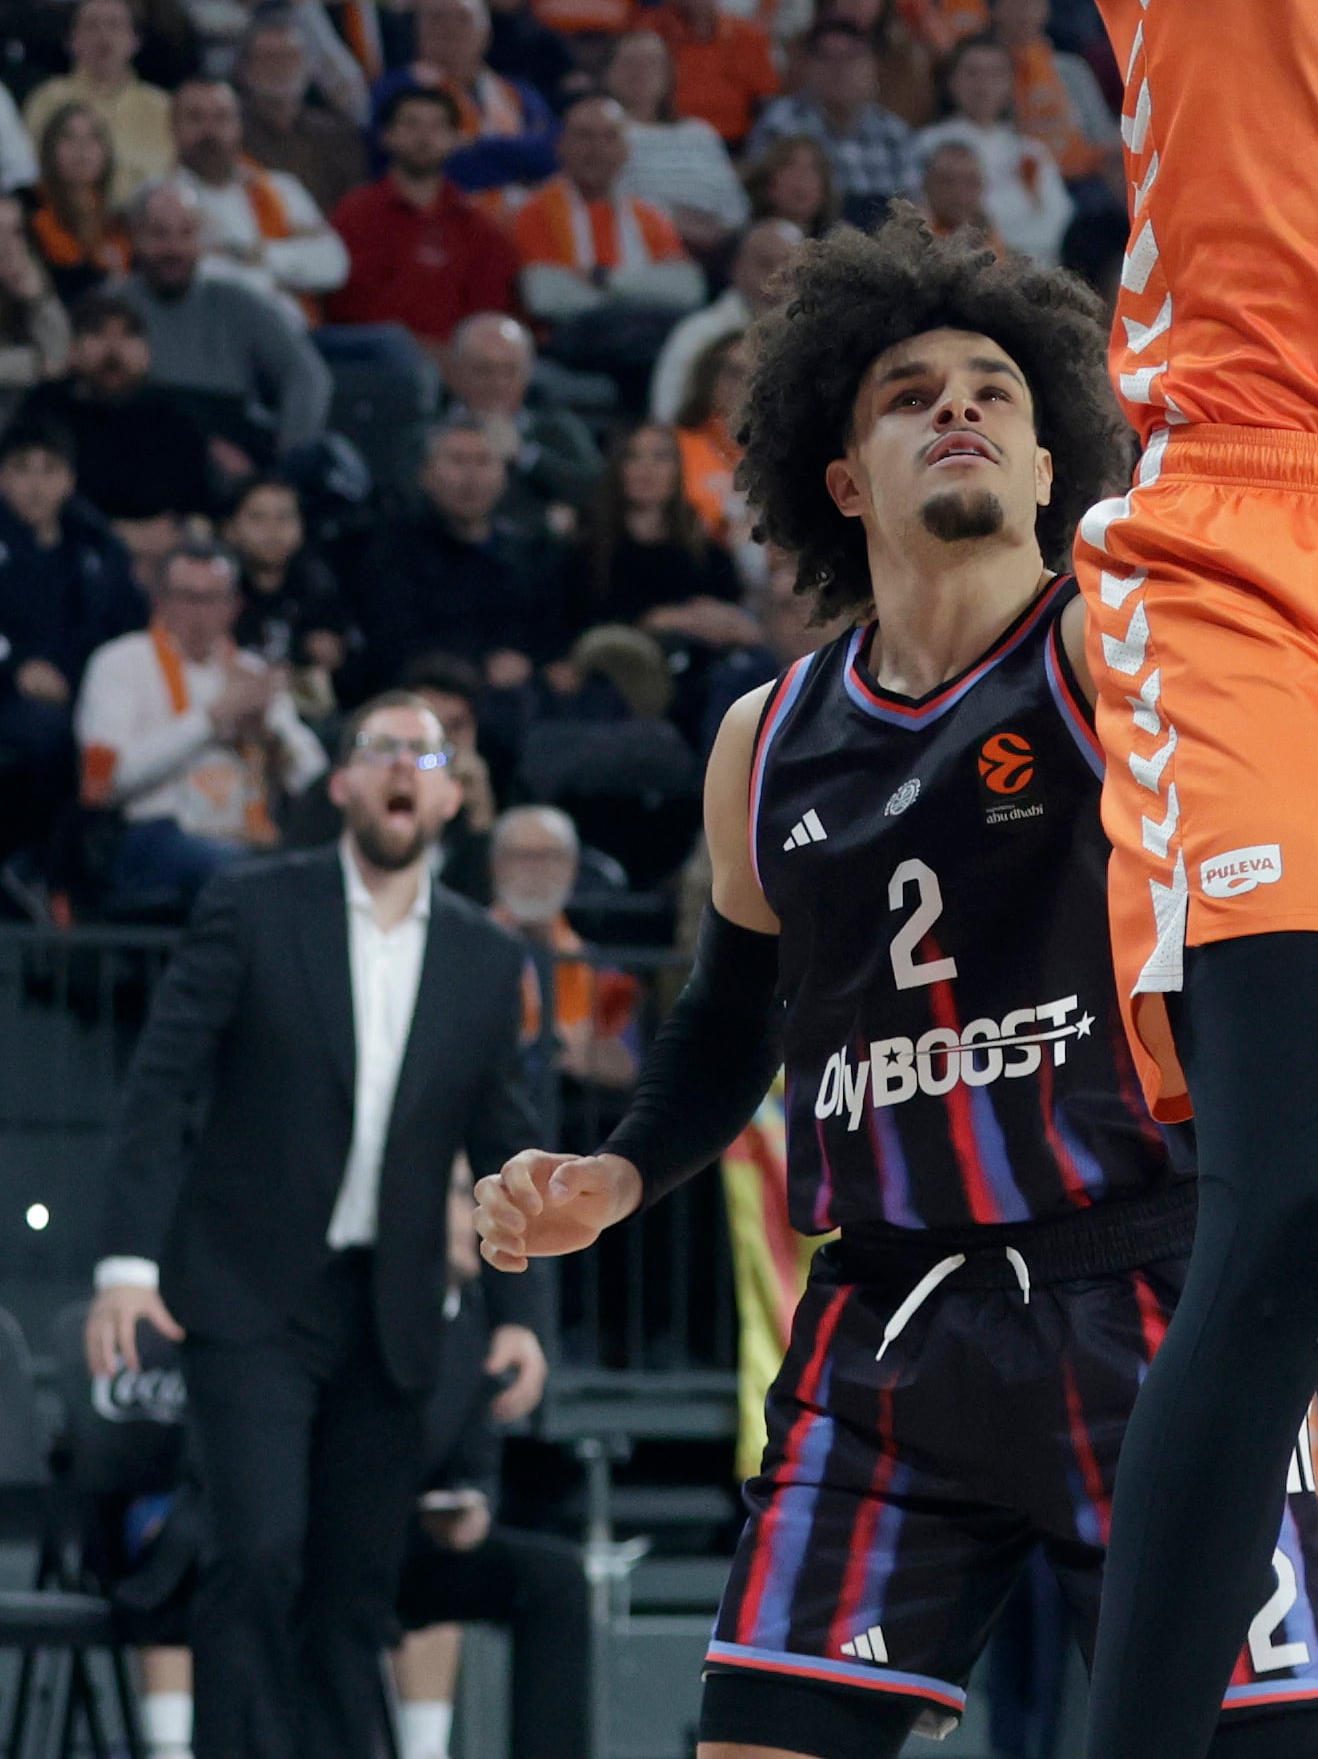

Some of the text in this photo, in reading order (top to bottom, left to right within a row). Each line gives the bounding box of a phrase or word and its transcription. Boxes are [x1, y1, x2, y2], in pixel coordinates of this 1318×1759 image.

[887, 857, 958, 991] 2
[1206, 857, 1275, 884] PULEVA
[1247, 1546, 1311, 1674] 2
